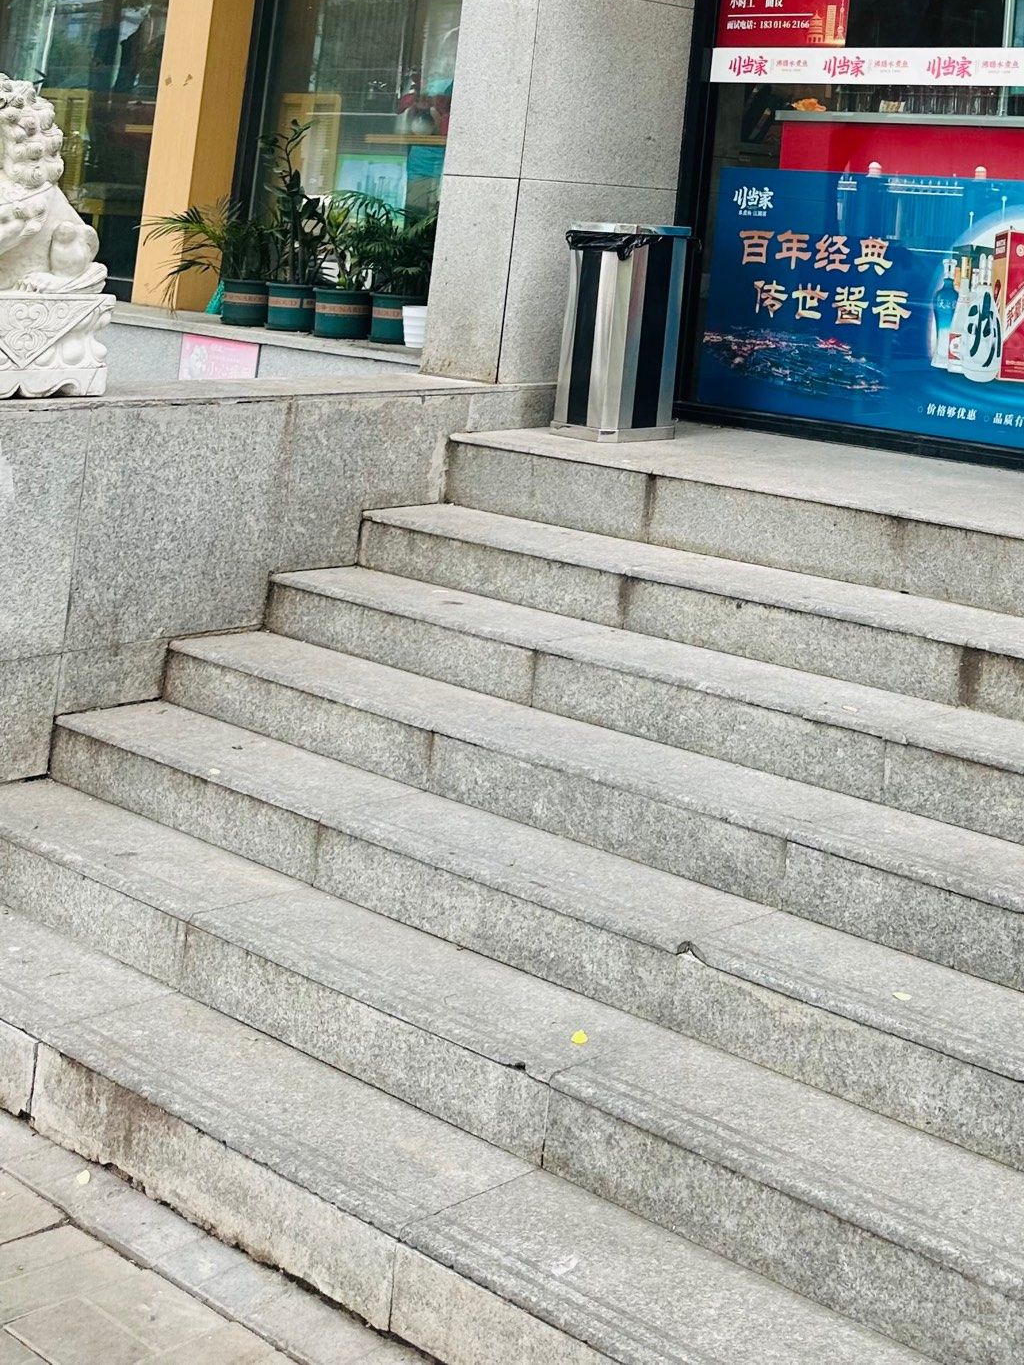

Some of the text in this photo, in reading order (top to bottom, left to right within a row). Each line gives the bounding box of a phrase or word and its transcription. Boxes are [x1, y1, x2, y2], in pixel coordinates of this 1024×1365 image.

[729, 56, 768, 76] 川当家
[823, 56, 865, 77] 川当家
[926, 56, 972, 79] 川当家
[733, 186, 774, 209] 川当家
[739, 229, 893, 275] 百年经典
[754, 280, 911, 330] 传世酱香
[926, 402, 977, 421] 价格够优惠
